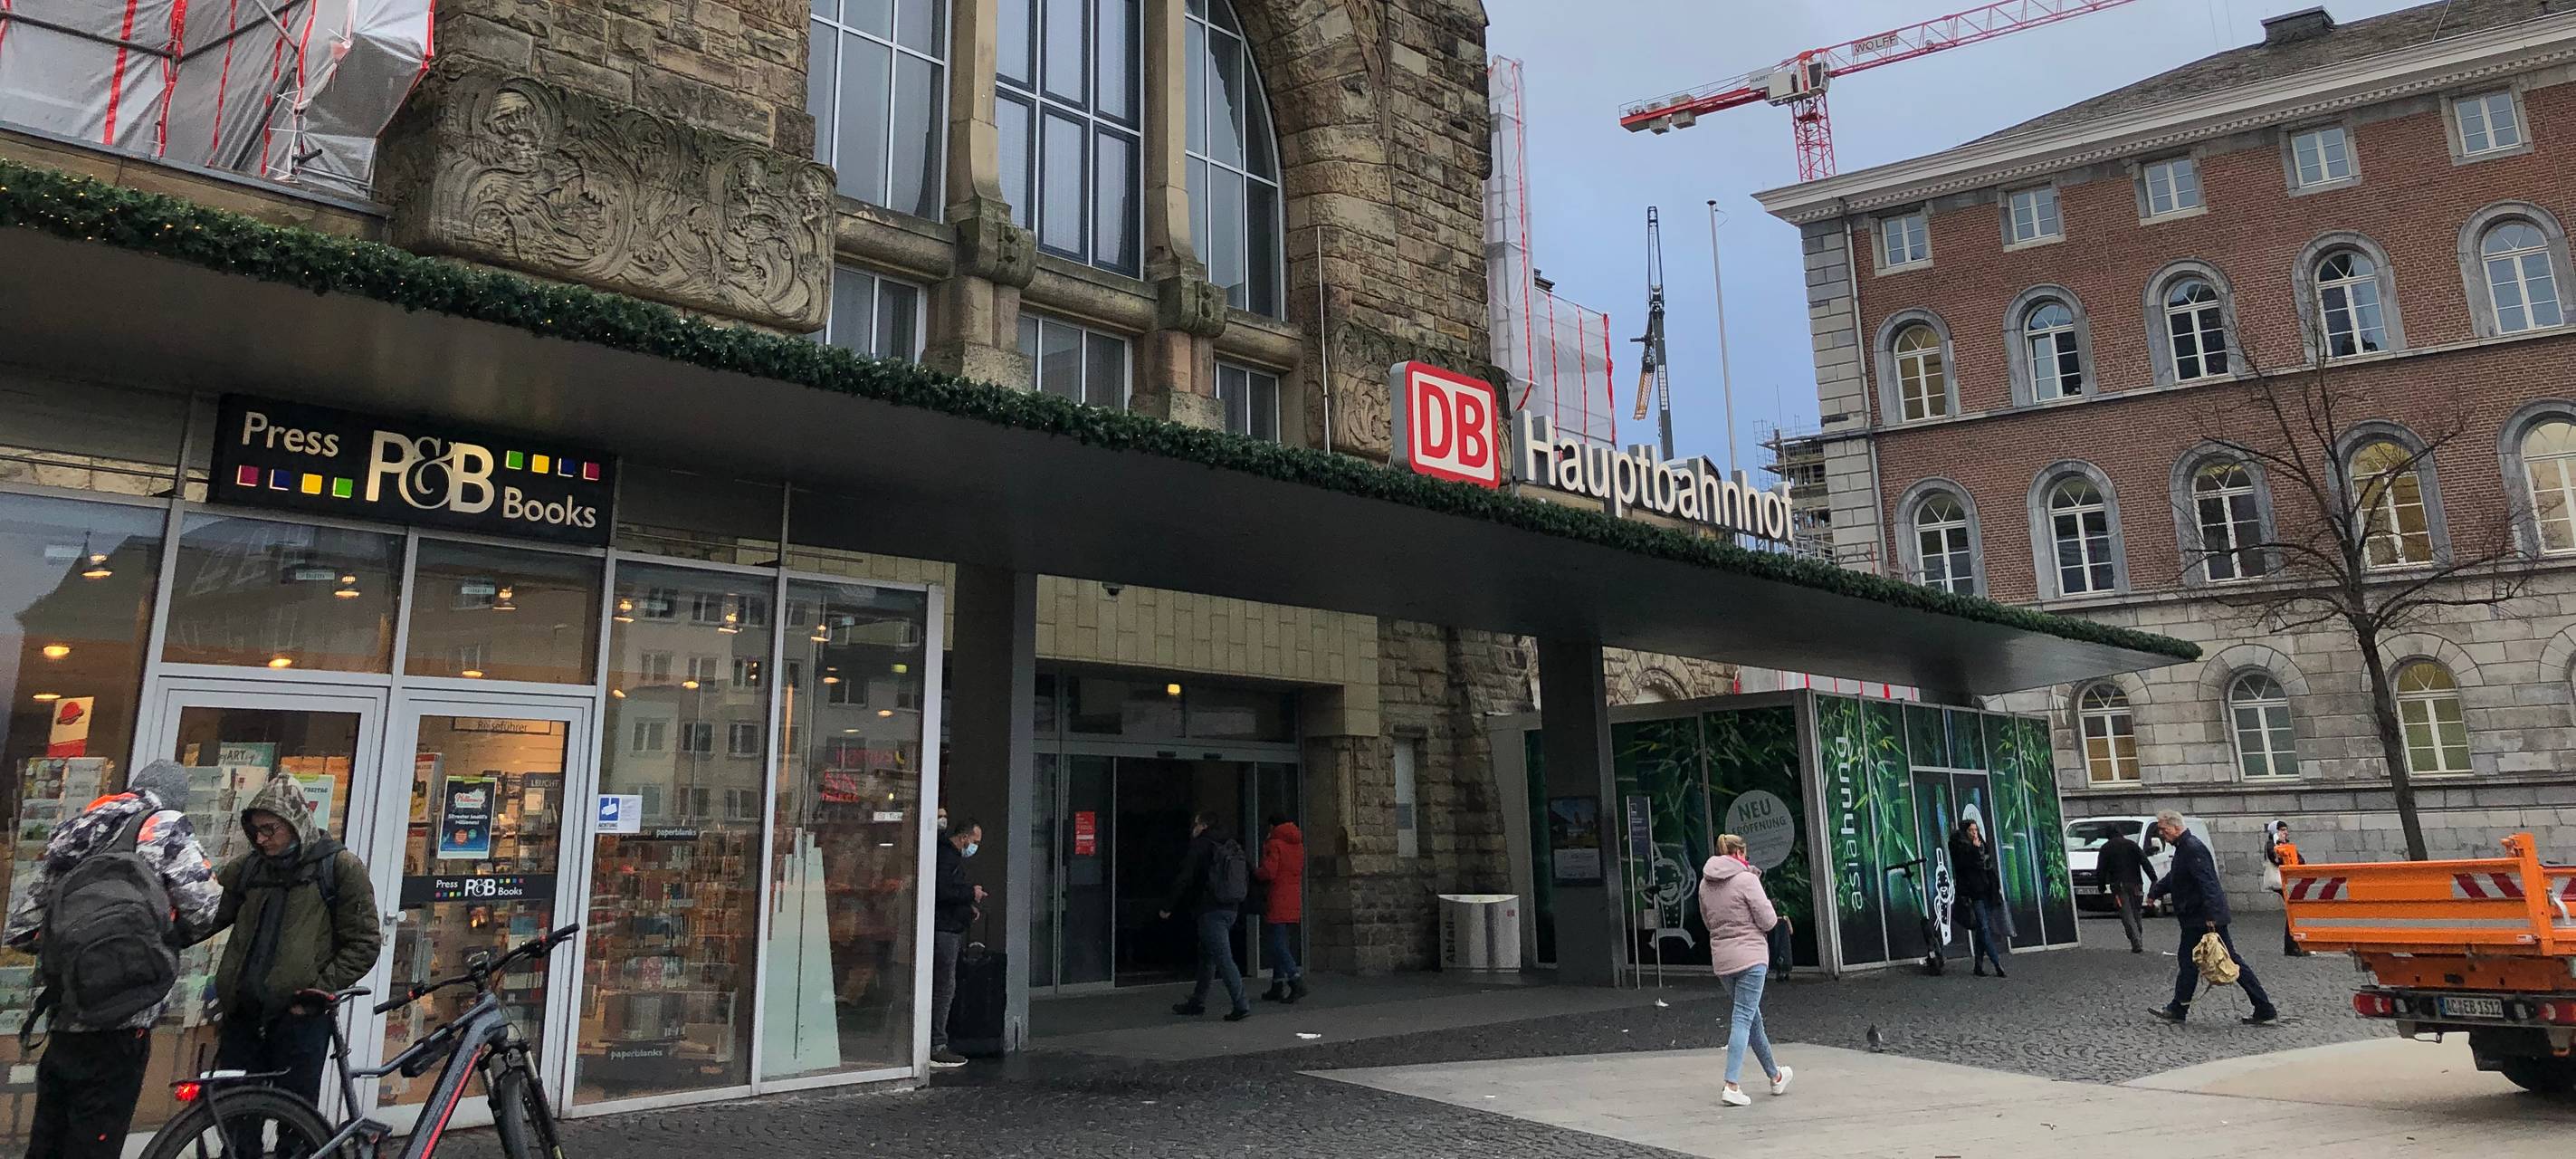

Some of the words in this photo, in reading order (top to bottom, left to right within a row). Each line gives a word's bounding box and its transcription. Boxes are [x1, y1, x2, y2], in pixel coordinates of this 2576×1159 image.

[1856, 37, 1896, 53] WOLFF
[1418, 381, 1489, 468] DB
[242, 411, 339, 457] Press
[366, 430, 495, 514] P&B
[502, 486, 596, 529] Books
[1524, 409, 1793, 541] Hauptbahnhof
[1738, 798, 1771, 822] NEU
[656, 829, 696, 838] paperblanks
[1836, 736, 1863, 912] asiahung
[435, 879, 458, 888] Press
[464, 878, 496, 897] P&B
[498, 886, 522, 896] Books
[2447, 999, 2458, 1013] AC
[2463, 1000, 2476, 1014] EB
[2477, 1001, 2501, 1015] 1312
[611, 1048, 663, 1060] paperblanks
